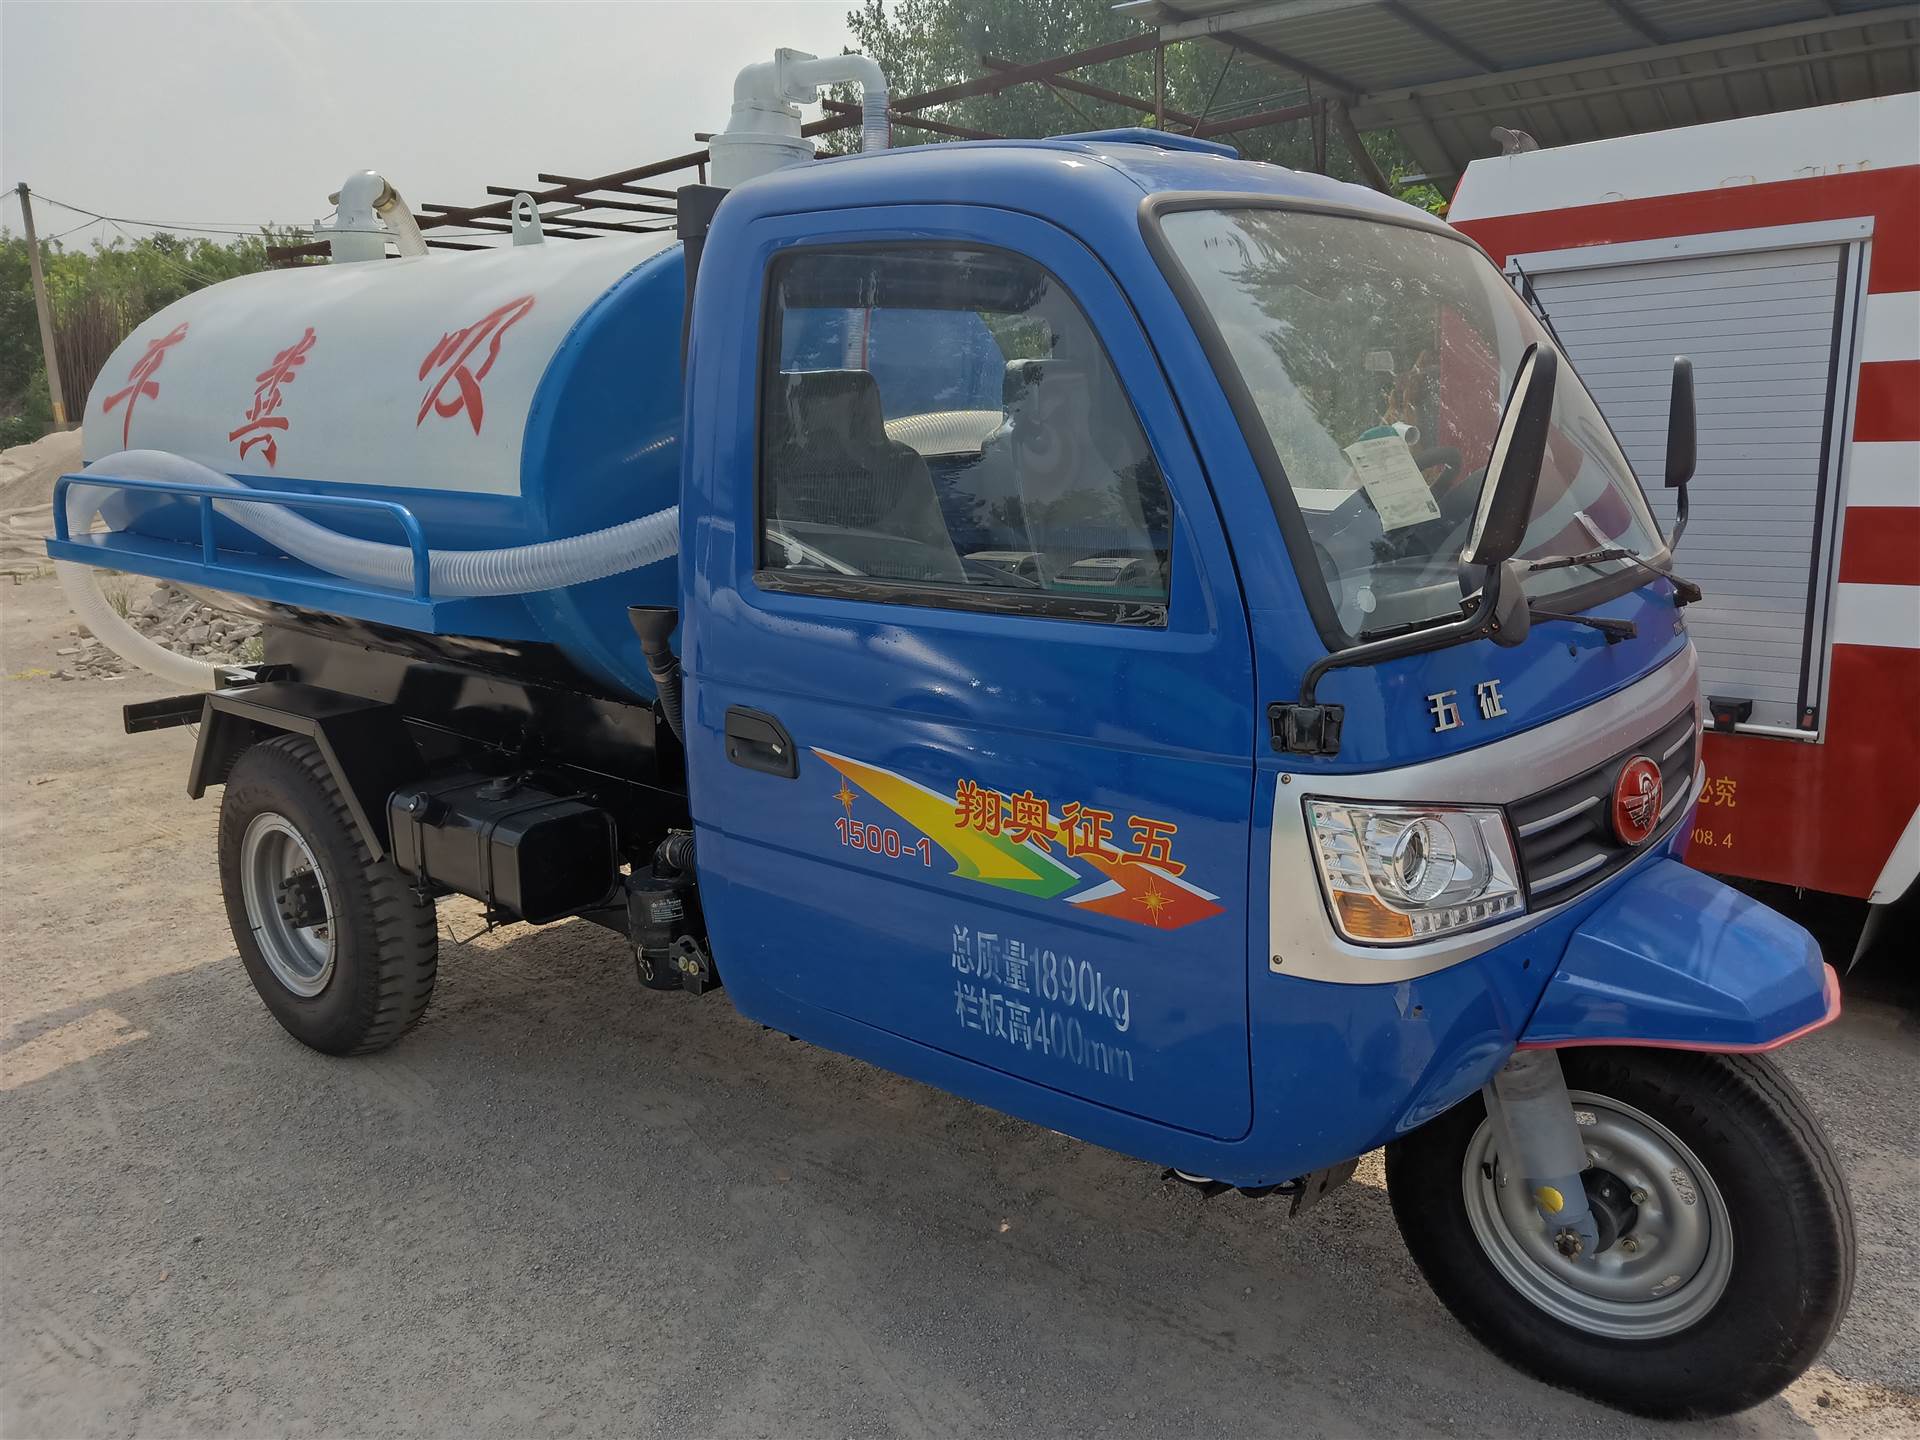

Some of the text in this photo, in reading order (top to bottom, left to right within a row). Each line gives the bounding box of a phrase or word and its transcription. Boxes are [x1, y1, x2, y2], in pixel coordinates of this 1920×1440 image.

[1427, 679, 1508, 733] 五征
[835, 817, 931, 867] 1500-1
[1690, 827, 1734, 849] 08.4
[951, 924, 1130, 1032] 总质量1890kg
[953, 979, 1135, 1082] 栏板高400mm
